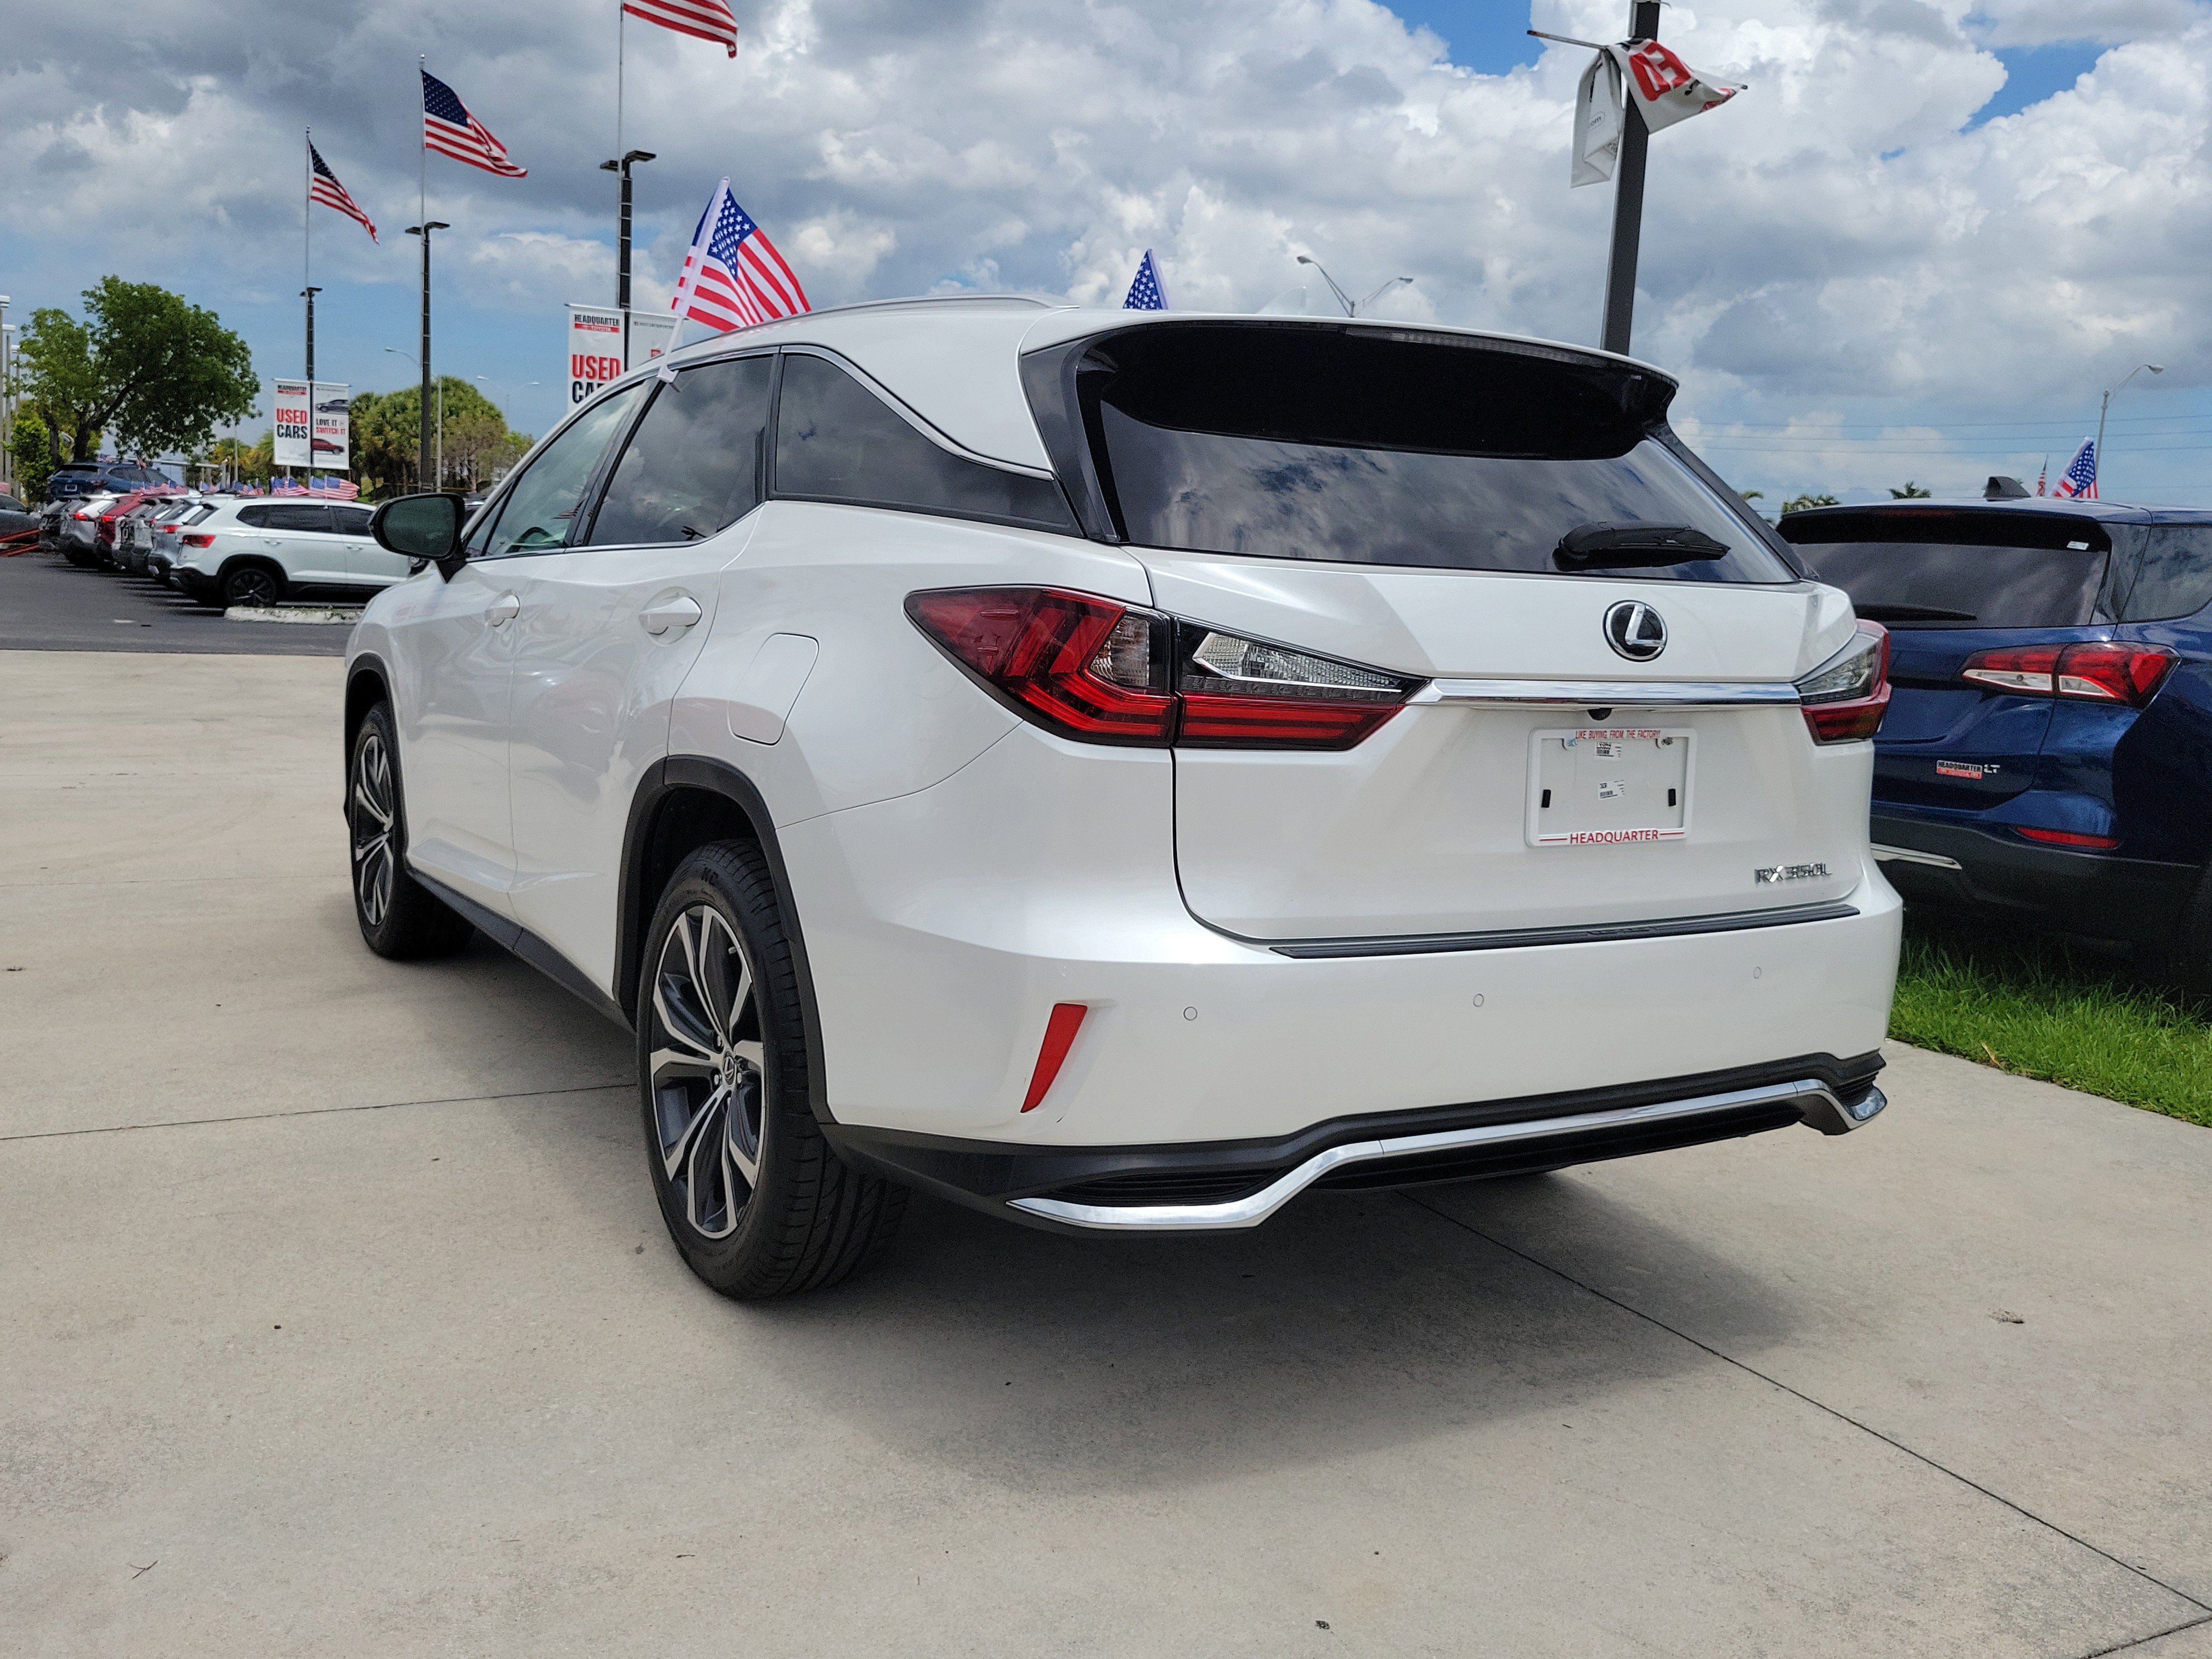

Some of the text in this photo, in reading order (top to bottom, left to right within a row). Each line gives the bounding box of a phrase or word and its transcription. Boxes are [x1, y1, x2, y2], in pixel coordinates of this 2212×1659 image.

[574, 314, 620, 326] HEADQUARTER
[572, 354, 621, 381] USED
[572, 381, 605, 404] CA
[276, 408, 307, 424] USED
[277, 424, 308, 439] CARS
[1576, 730, 1585, 738] LIKE
[1589, 730, 1607, 738] BUYING
[1610, 730, 1624, 738] FROM
[1626, 730, 1635, 738] THE
[1984, 764, 2000, 773] LT
[1570, 830, 1658, 844] HEADQUARTER
